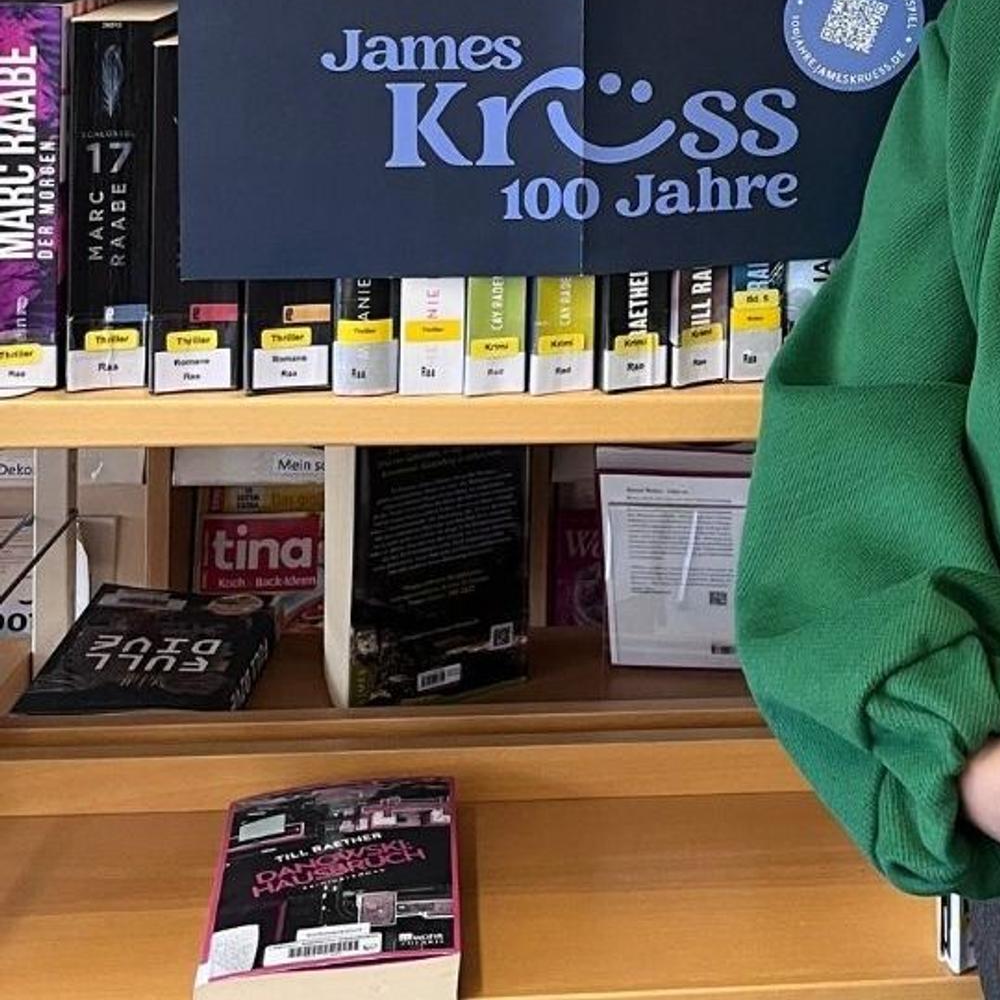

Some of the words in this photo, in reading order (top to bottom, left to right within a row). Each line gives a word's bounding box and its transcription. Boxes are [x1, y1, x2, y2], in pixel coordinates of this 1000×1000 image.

[320, 29, 523, 72] James
[0, 45, 38, 156] RAABE
[384, 65, 799, 168] Krüss
[86, 142, 134, 174] 17
[0, 164, 35, 260] MARC
[502, 177, 600, 221] 100
[615, 166, 799, 219] Jahre
[37, 227, 54, 260] DER
[89, 190, 104, 261] MARC
[110, 183, 128, 267] RAABE
[357, 278, 372, 321] ANIE
[691, 296, 712, 328] ILL
[0, 464, 33, 475] Deko
[278, 459, 311, 471] Mein
[212, 524, 313, 570] tina
[86, 652, 209, 672] FULL
[90, 635, 222, 655] DIVE
[275, 849, 308, 863] TILL
